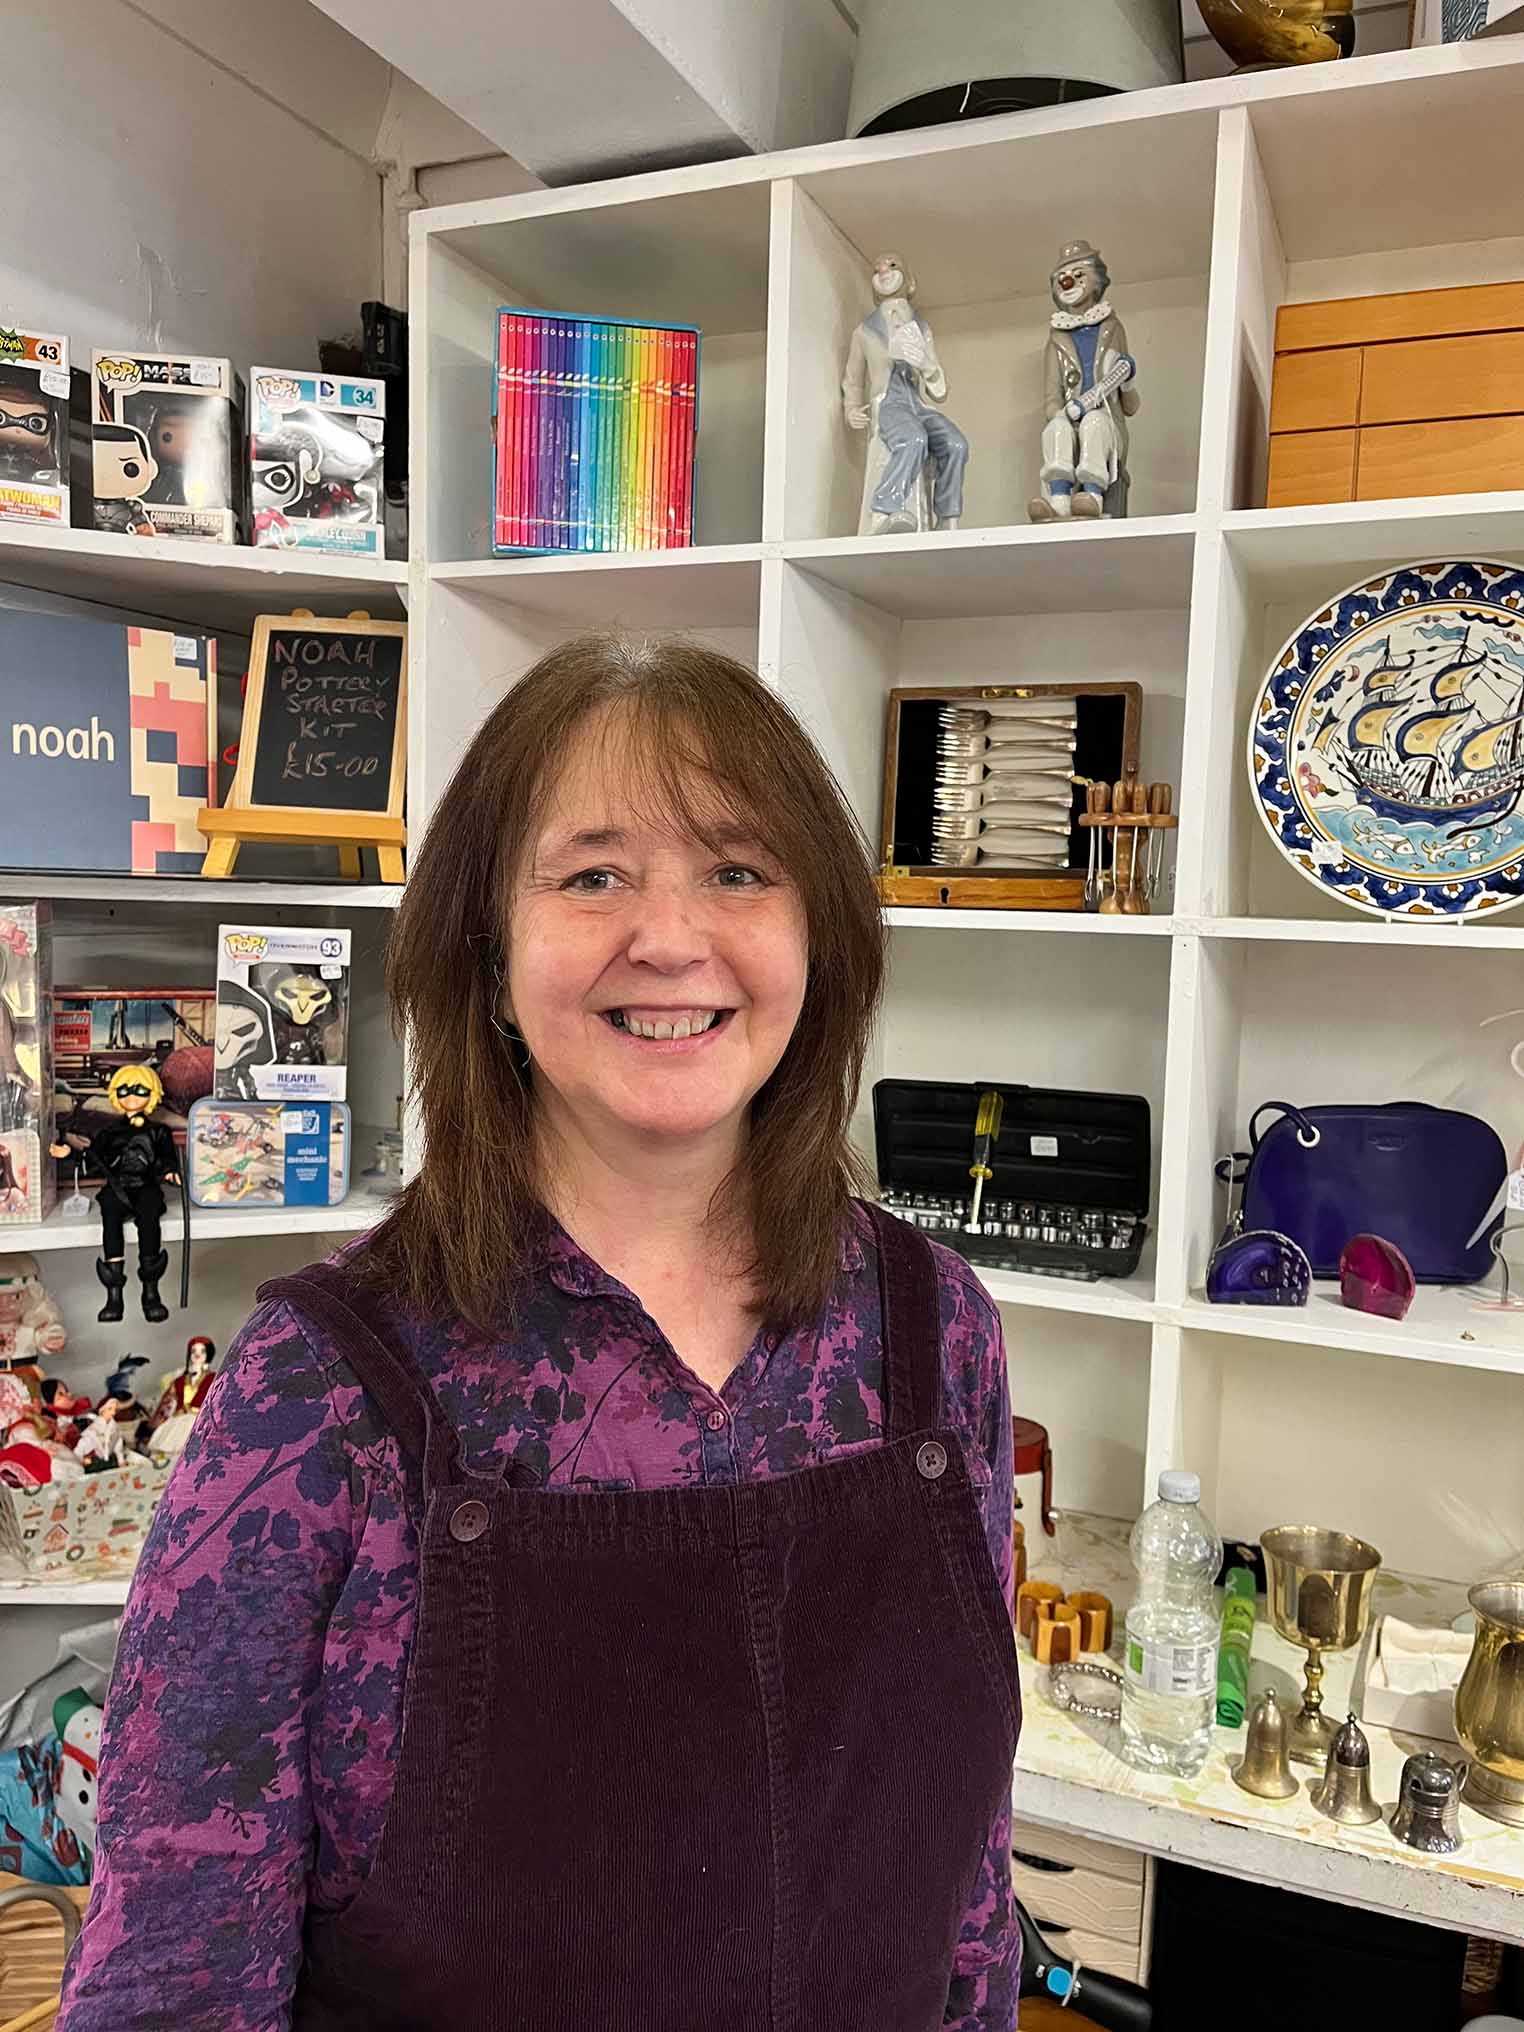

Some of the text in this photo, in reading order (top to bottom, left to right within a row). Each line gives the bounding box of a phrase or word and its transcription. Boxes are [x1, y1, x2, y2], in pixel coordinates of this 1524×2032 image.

[38, 344, 58, 360] 43
[97, 361, 141, 382] POP!
[257, 376, 300, 399] POP!
[354, 389, 373, 405] 34
[275, 639, 376, 668] NOAH
[12, 715, 115, 761] noah
[300, 717, 358, 739] KIT
[225, 933, 268, 953] POP!
[322, 940, 340, 956] 93
[277, 1072, 317, 1084] REAPER
